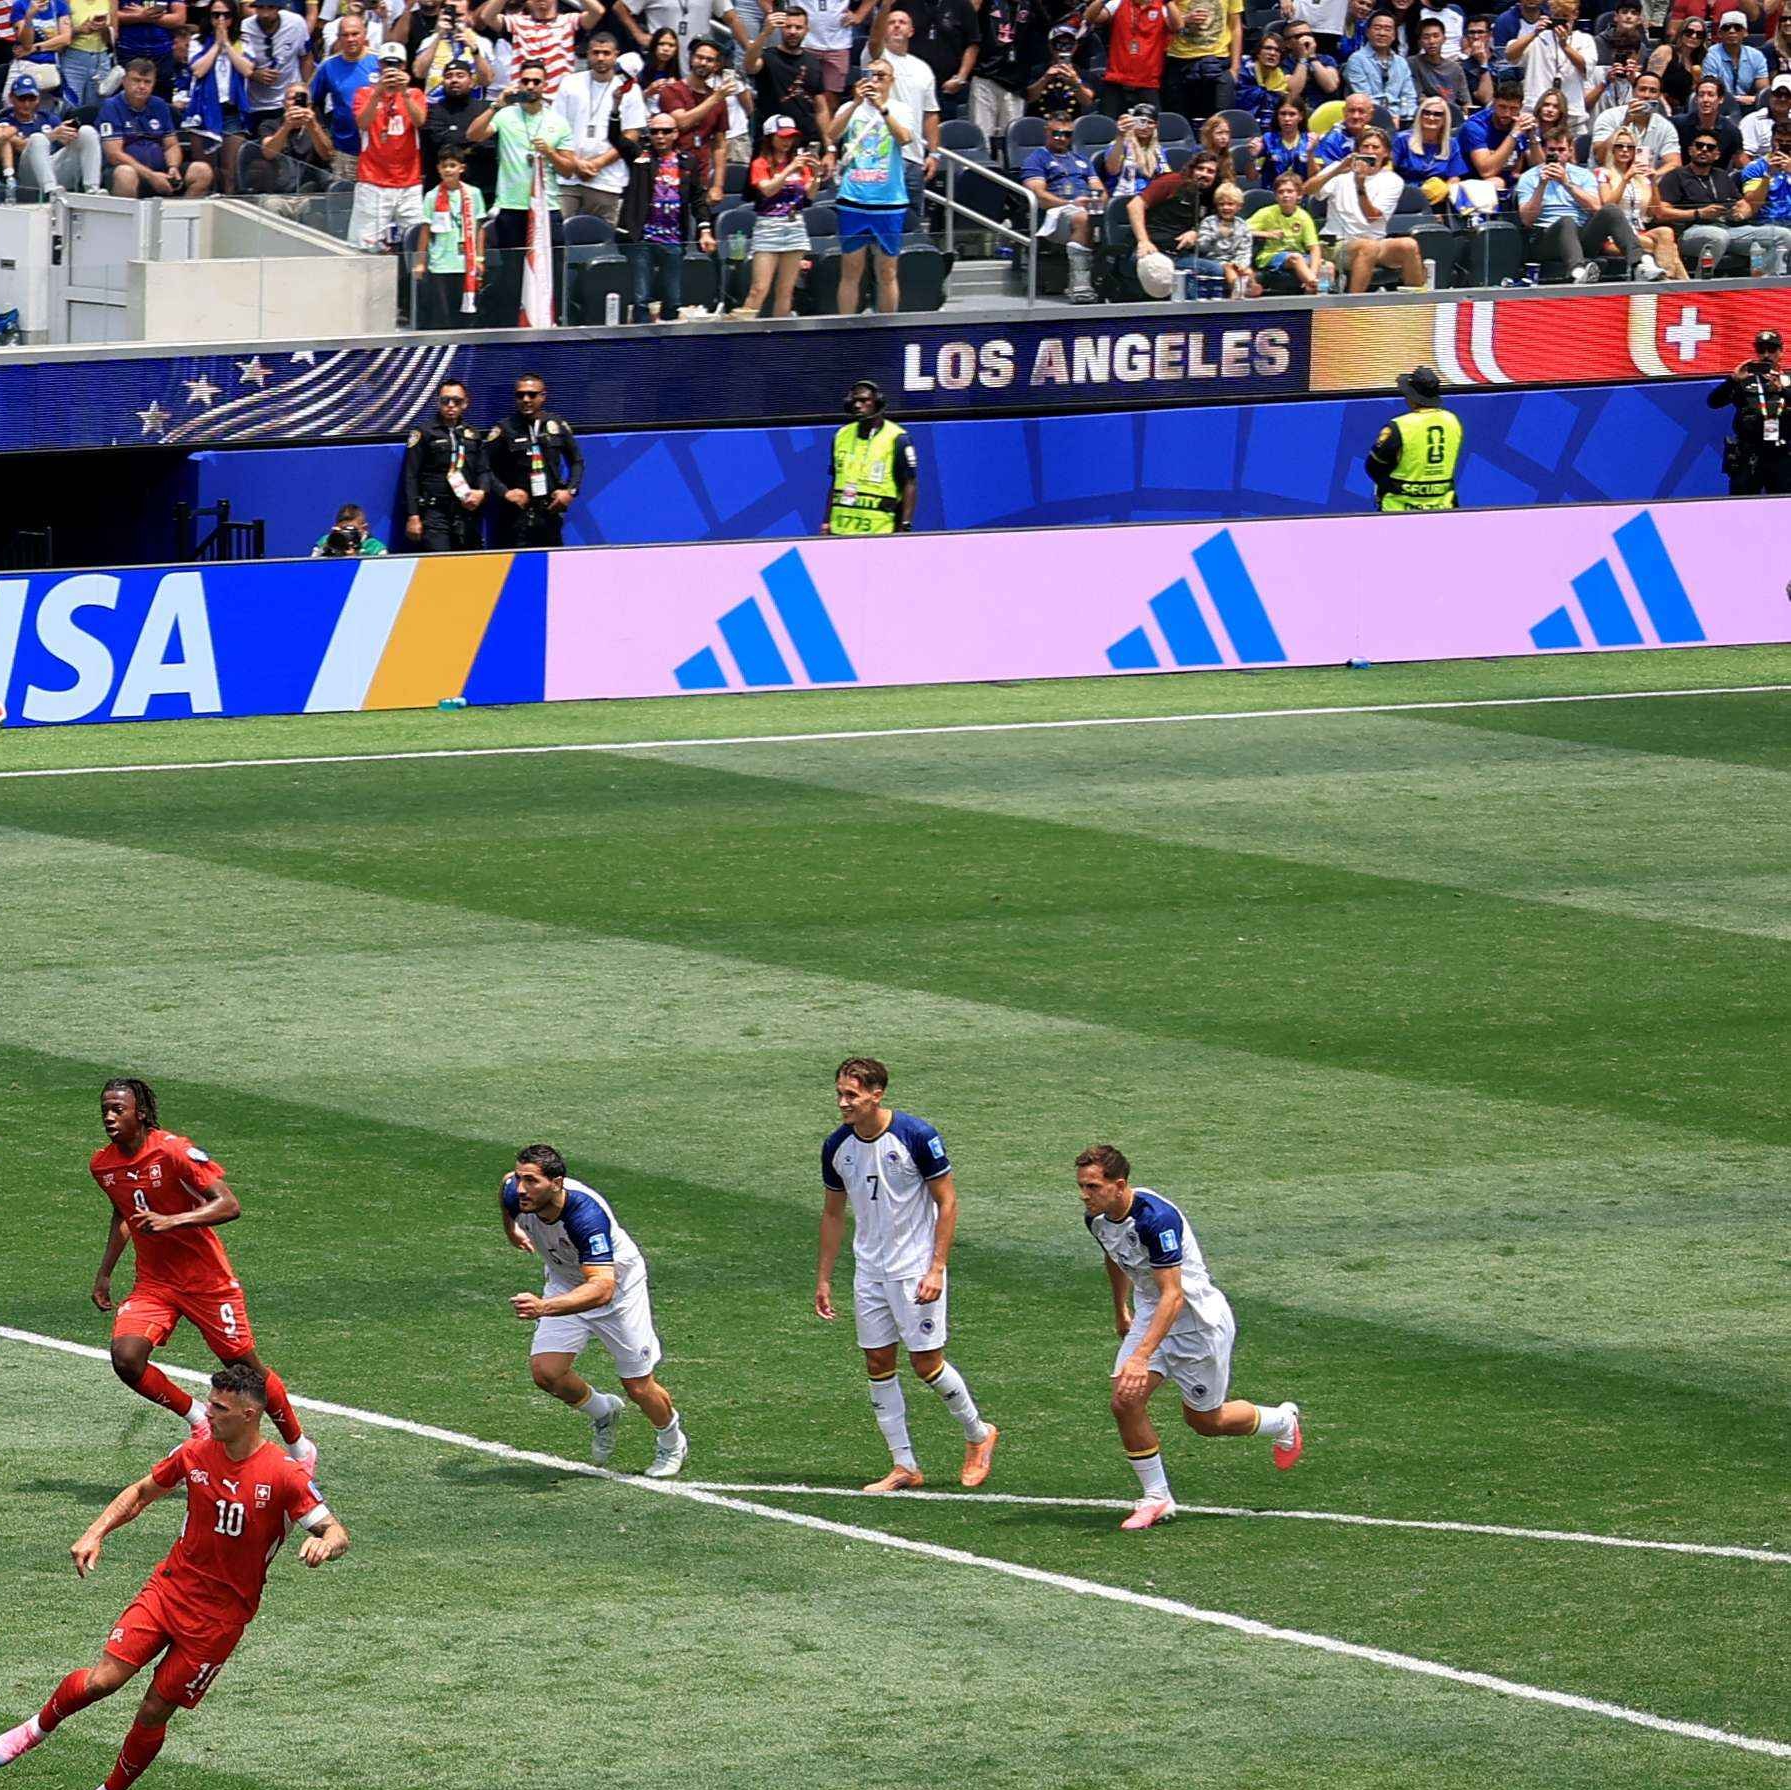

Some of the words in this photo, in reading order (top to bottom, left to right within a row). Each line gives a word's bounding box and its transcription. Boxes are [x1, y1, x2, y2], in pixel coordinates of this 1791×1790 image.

[903, 340, 1015, 391] LOS
[1029, 328, 1291, 386] ANGELES
[866, 1175, 878, 1200] 7
[220, 1303, 237, 1335] 9
[213, 1500, 245, 1537] 10
